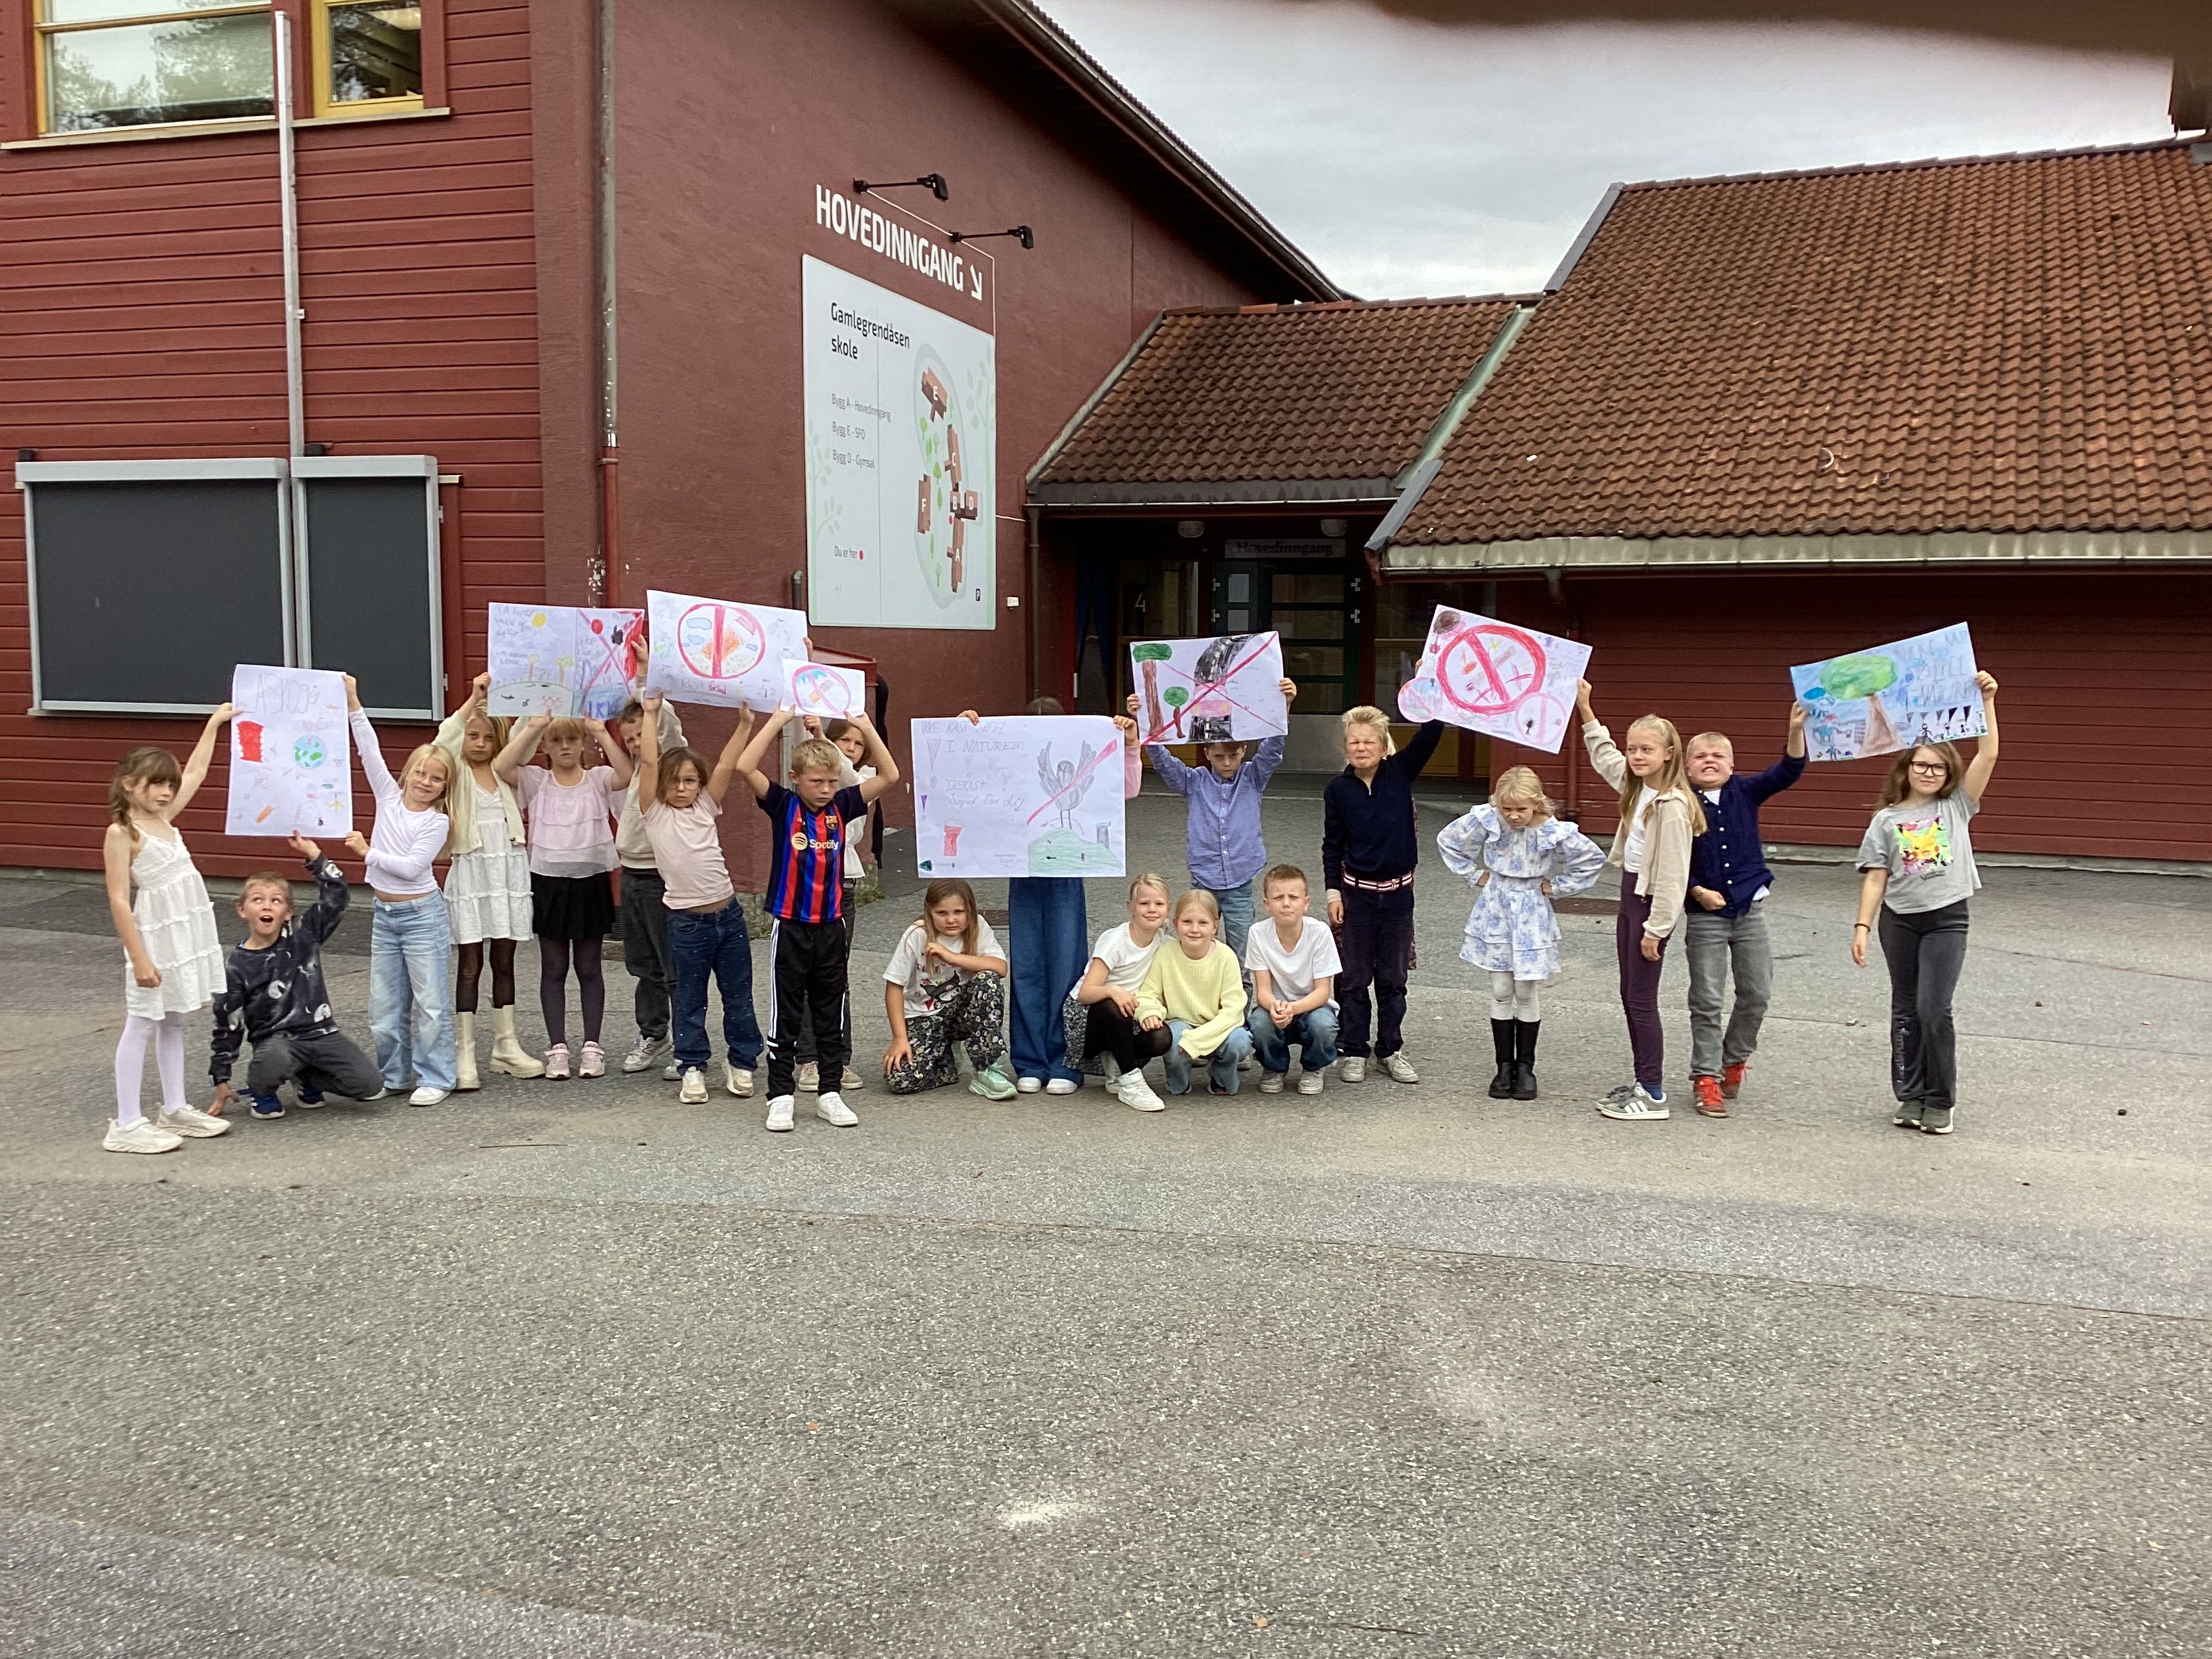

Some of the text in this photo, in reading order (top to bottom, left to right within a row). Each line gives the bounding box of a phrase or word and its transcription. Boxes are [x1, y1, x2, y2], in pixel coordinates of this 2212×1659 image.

[816, 184, 963, 292] HOVEDINNGANG
[831, 302, 909, 348] Gamlegrendåsen
[832, 335, 858, 359] skole
[933, 386, 939, 401] E
[832, 393, 846, 410] Bygg
[846, 398, 851, 408] A
[855, 400, 891, 422] Hovedinngang
[832, 421, 846, 438] Bygg
[847, 425, 851, 436] E
[855, 427, 866, 439] SFO
[833, 449, 847, 465] Bygg
[847, 452, 852, 463] D
[856, 454, 876, 469] Gymsal
[951, 453, 956, 466] C
[921, 498, 926, 512] F
[834, 546, 842, 556] Du
[849, 547, 858, 558] her
[955, 548, 960, 562] A
[1134, 592, 1145, 613] 4
[945, 740, 955, 753] I
[810, 838, 840, 851] Spotify
